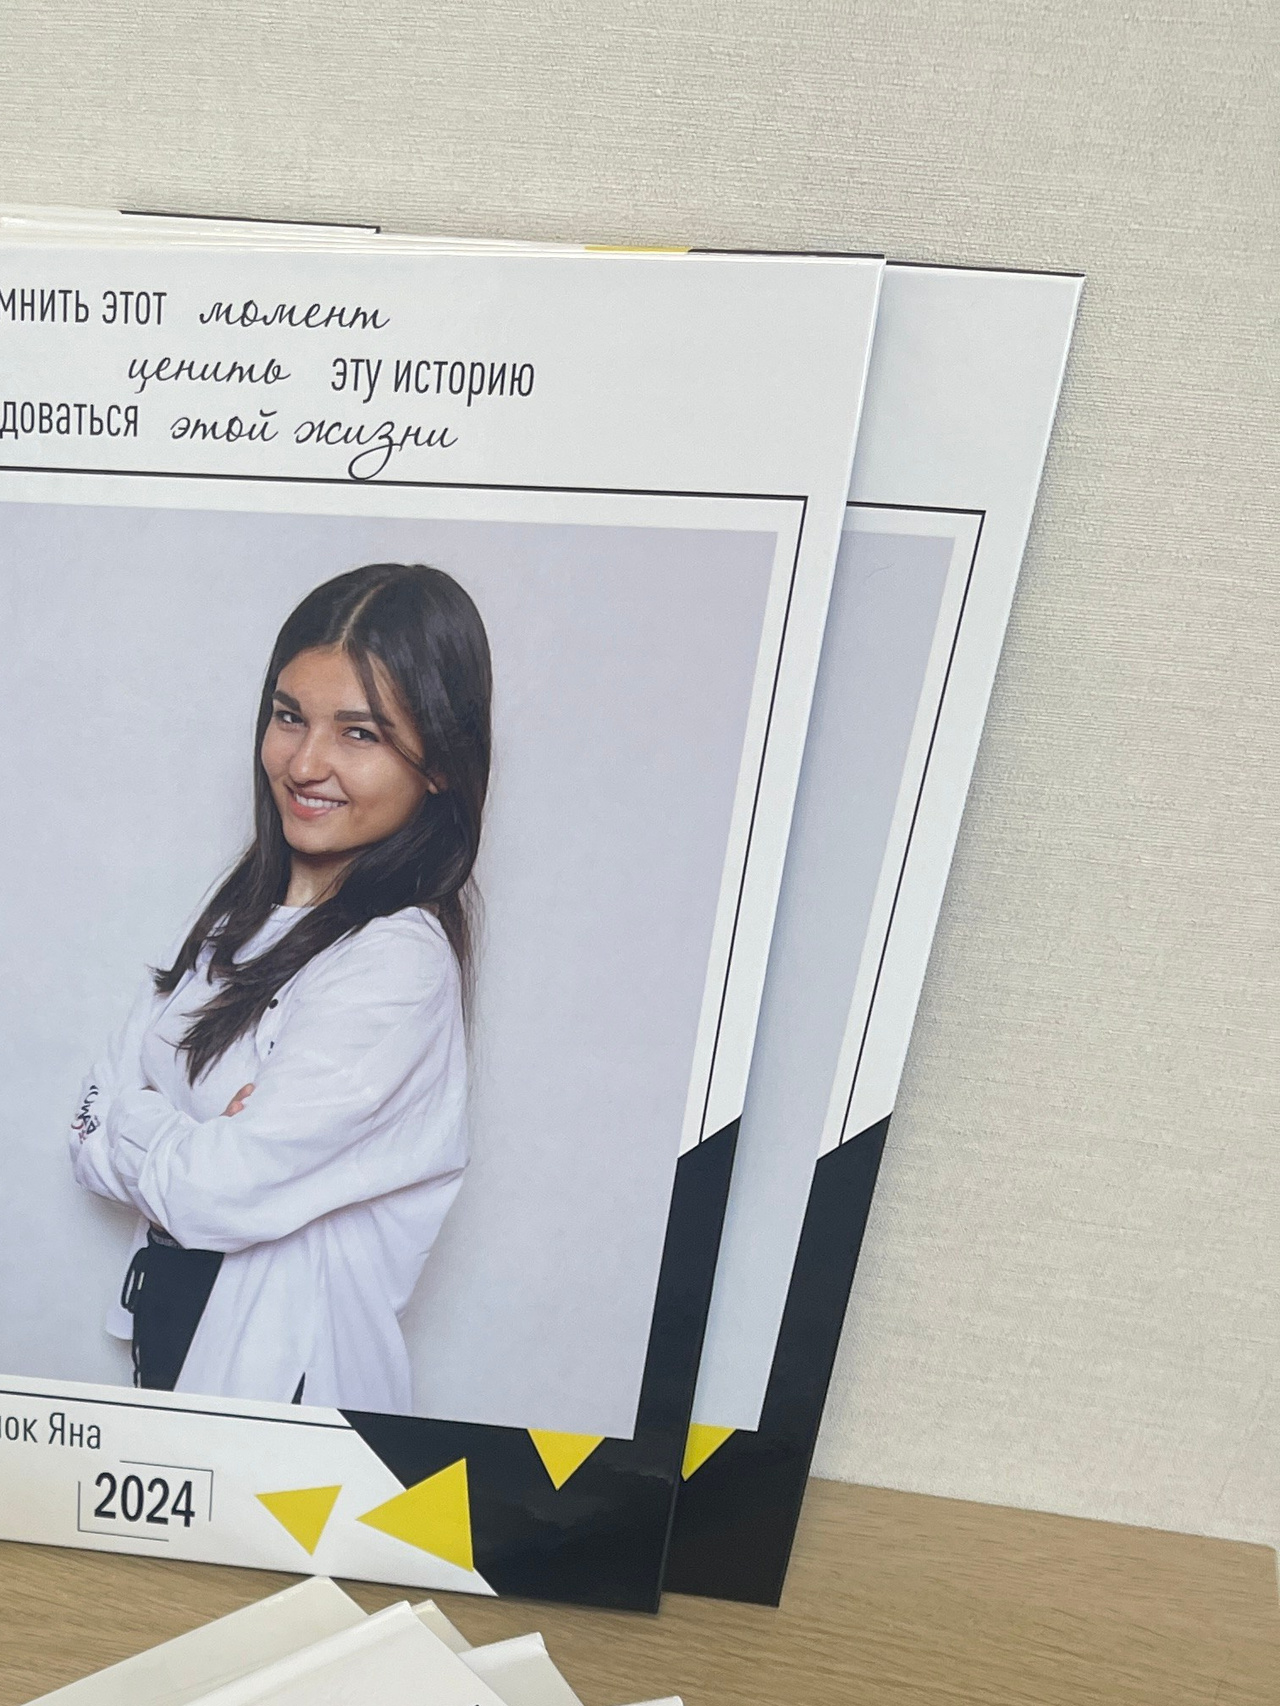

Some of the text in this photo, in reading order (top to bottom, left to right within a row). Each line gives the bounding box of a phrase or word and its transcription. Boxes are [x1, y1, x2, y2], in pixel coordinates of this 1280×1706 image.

[102, 291, 166, 325] этот
[199, 300, 391, 331] момент
[128, 356, 535, 407] ценить эту историю
[170, 410, 279, 443] этой
[294, 419, 458, 482] жизни
[48, 1412, 102, 1451] Яна
[93, 1471, 196, 1529] 2024
